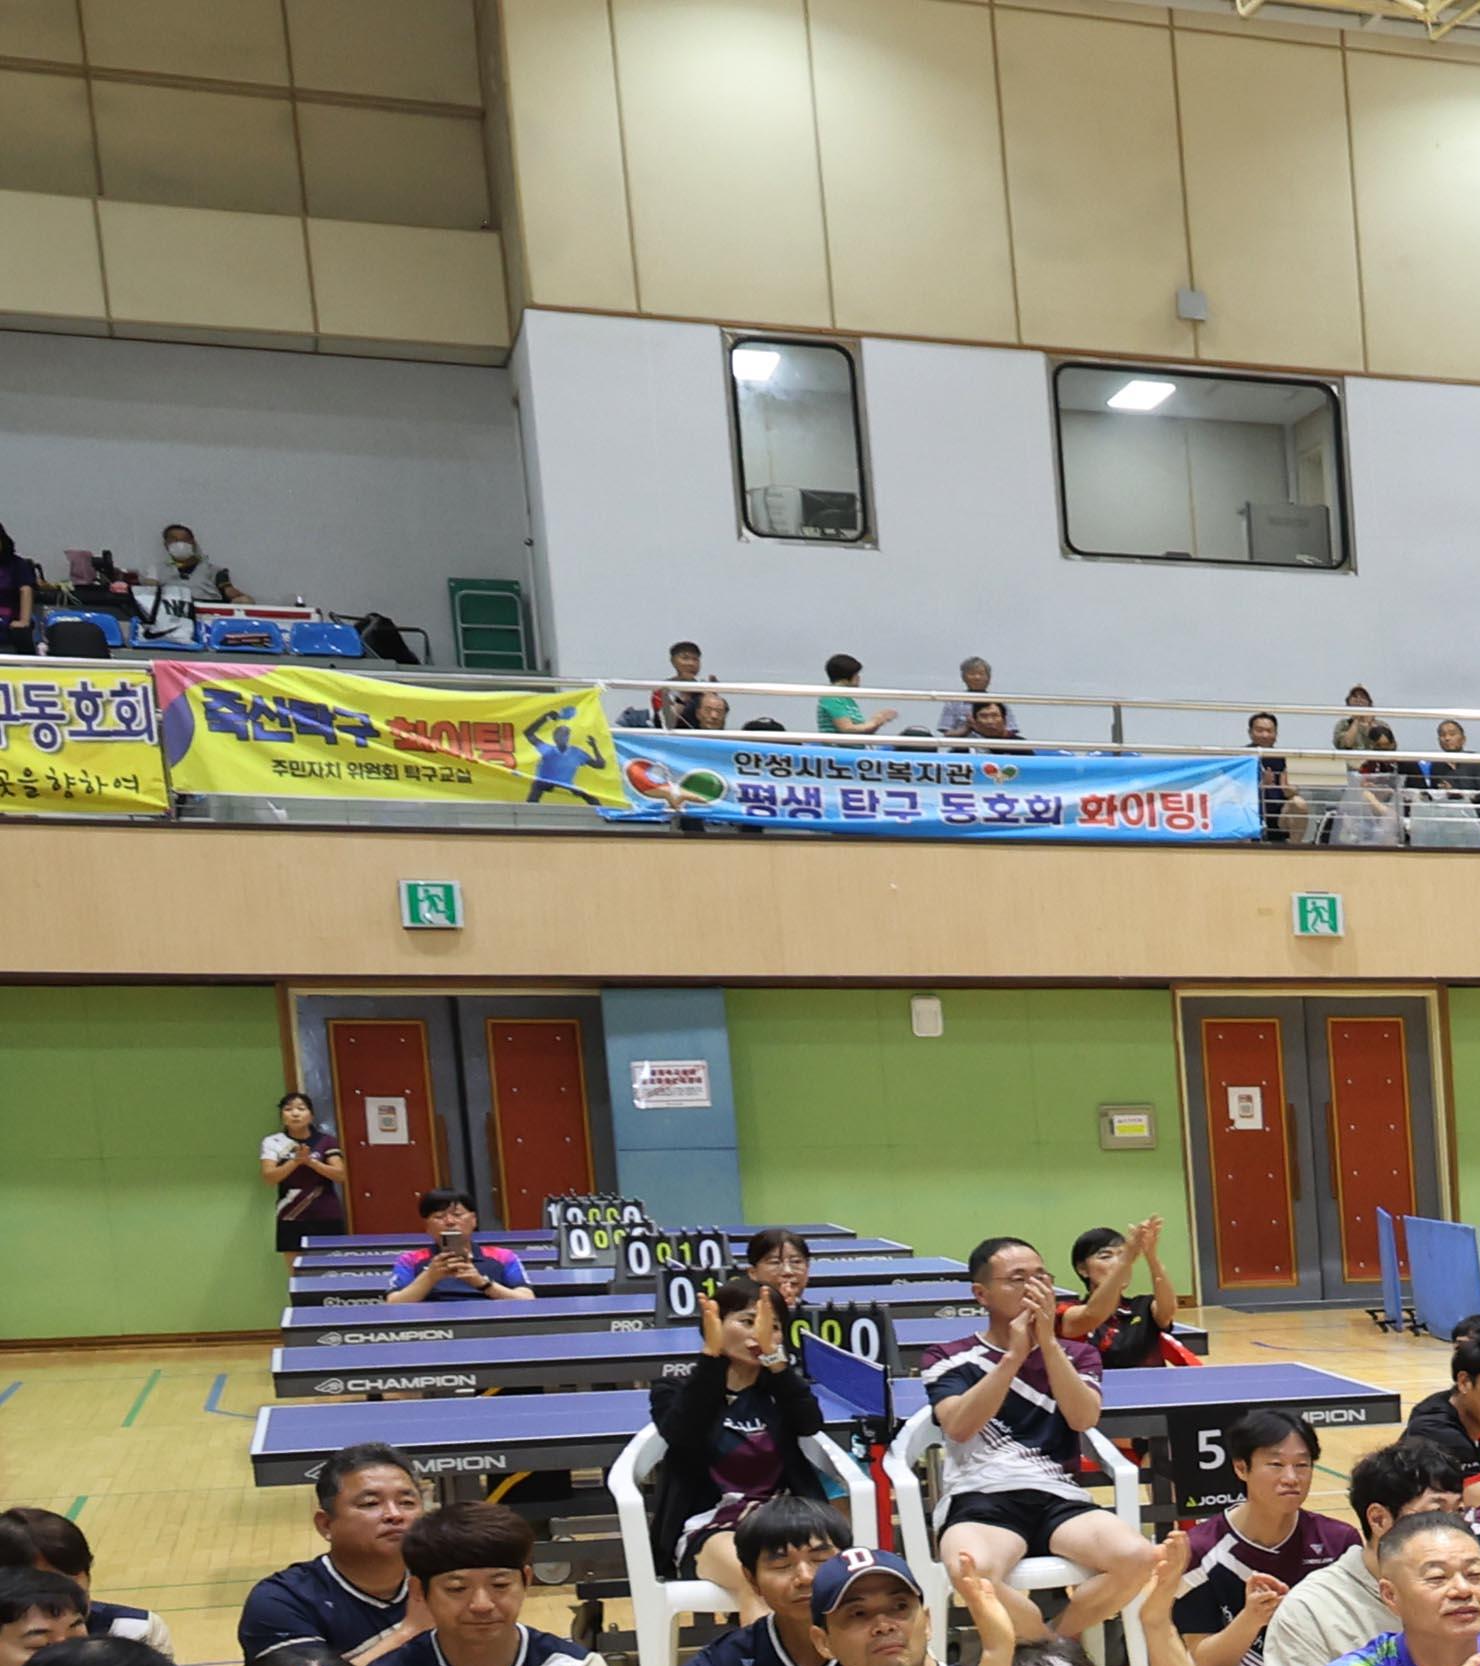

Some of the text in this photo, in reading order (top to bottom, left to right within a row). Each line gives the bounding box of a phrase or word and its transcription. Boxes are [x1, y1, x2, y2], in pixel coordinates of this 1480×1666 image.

[272, 759, 473, 784] 주민자치 위원회 탁구교실
[733, 751, 974, 786] 안성시노인복지관
[45, 770, 139, 798] 향하여
[735, 783, 1210, 831] 평생 탁구 동호회 화이팅!
[569, 1228, 592, 1258] 0
[627, 1241, 651, 1276] 0
[669, 1276, 696, 1317] 0
[344, 1329, 454, 1344] CHAMPION
[346, 1373, 477, 1392] CHAMPION
[1299, 1407, 1367, 1425] MPION
[1197, 1429, 1226, 1470] 5
[412, 1454, 507, 1474] MPION
[1197, 1491, 1247, 1506] JOOLA
